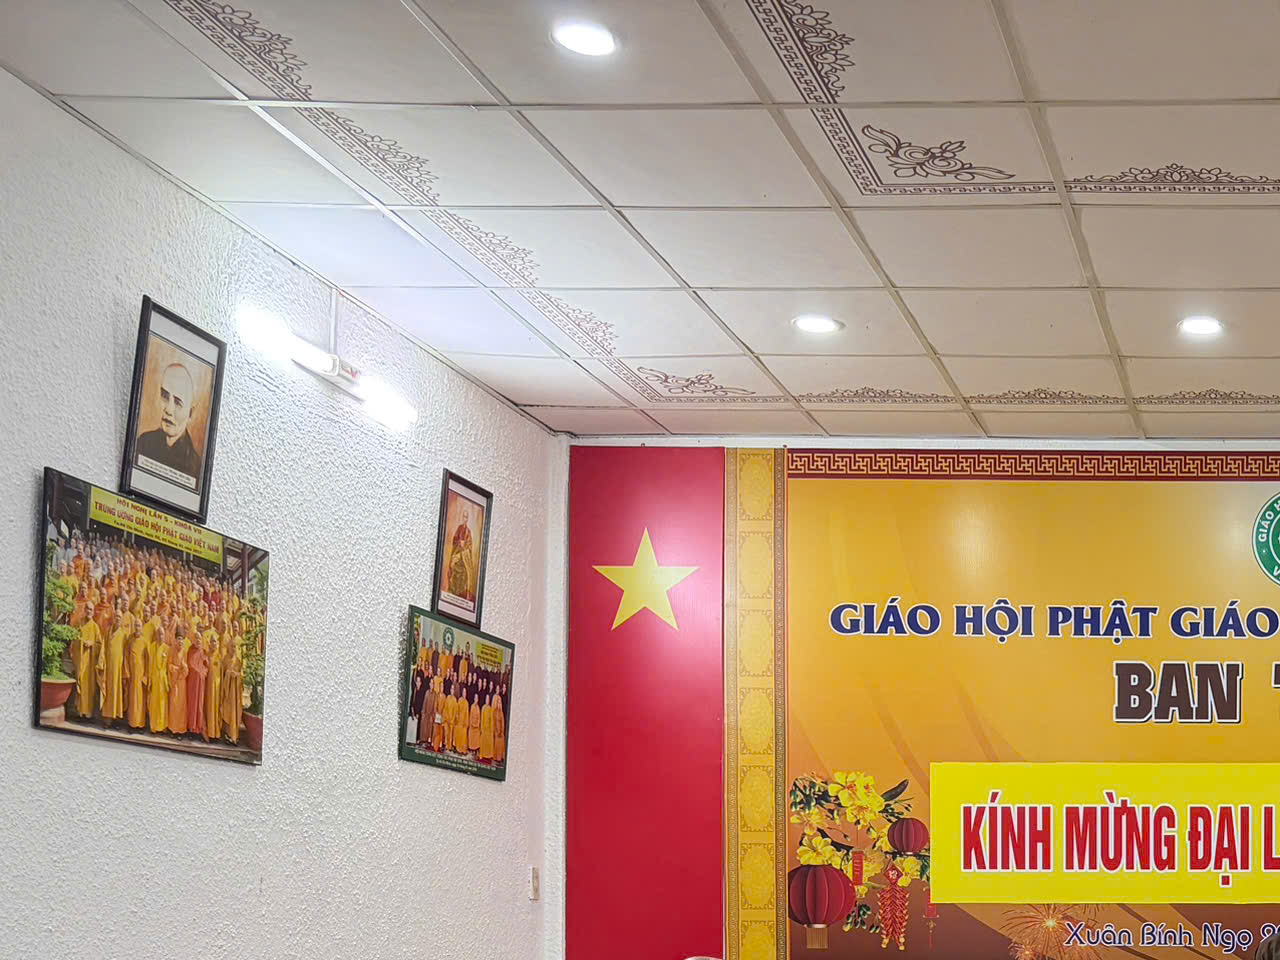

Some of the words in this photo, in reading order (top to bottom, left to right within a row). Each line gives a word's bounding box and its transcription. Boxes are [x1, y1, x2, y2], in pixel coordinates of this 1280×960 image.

[1258, 511, 1275, 542] GIÁO
[830, 598, 941, 635] GIÁO
[953, 599, 1034, 644] HỘI
[1048, 600, 1158, 645] PHẬT
[1170, 601, 1280, 638] GIÁO
[1114, 662, 1242, 723] BAN
[961, 790, 1054, 873] KÍNH
[1064, 790, 1176, 872] MỪNG
[1187, 805, 1251, 887] ĐẠI
[1064, 921, 1133, 947] Xuân
[1140, 921, 1193, 948] Bính
[1202, 922, 1254, 954] Ngọ
